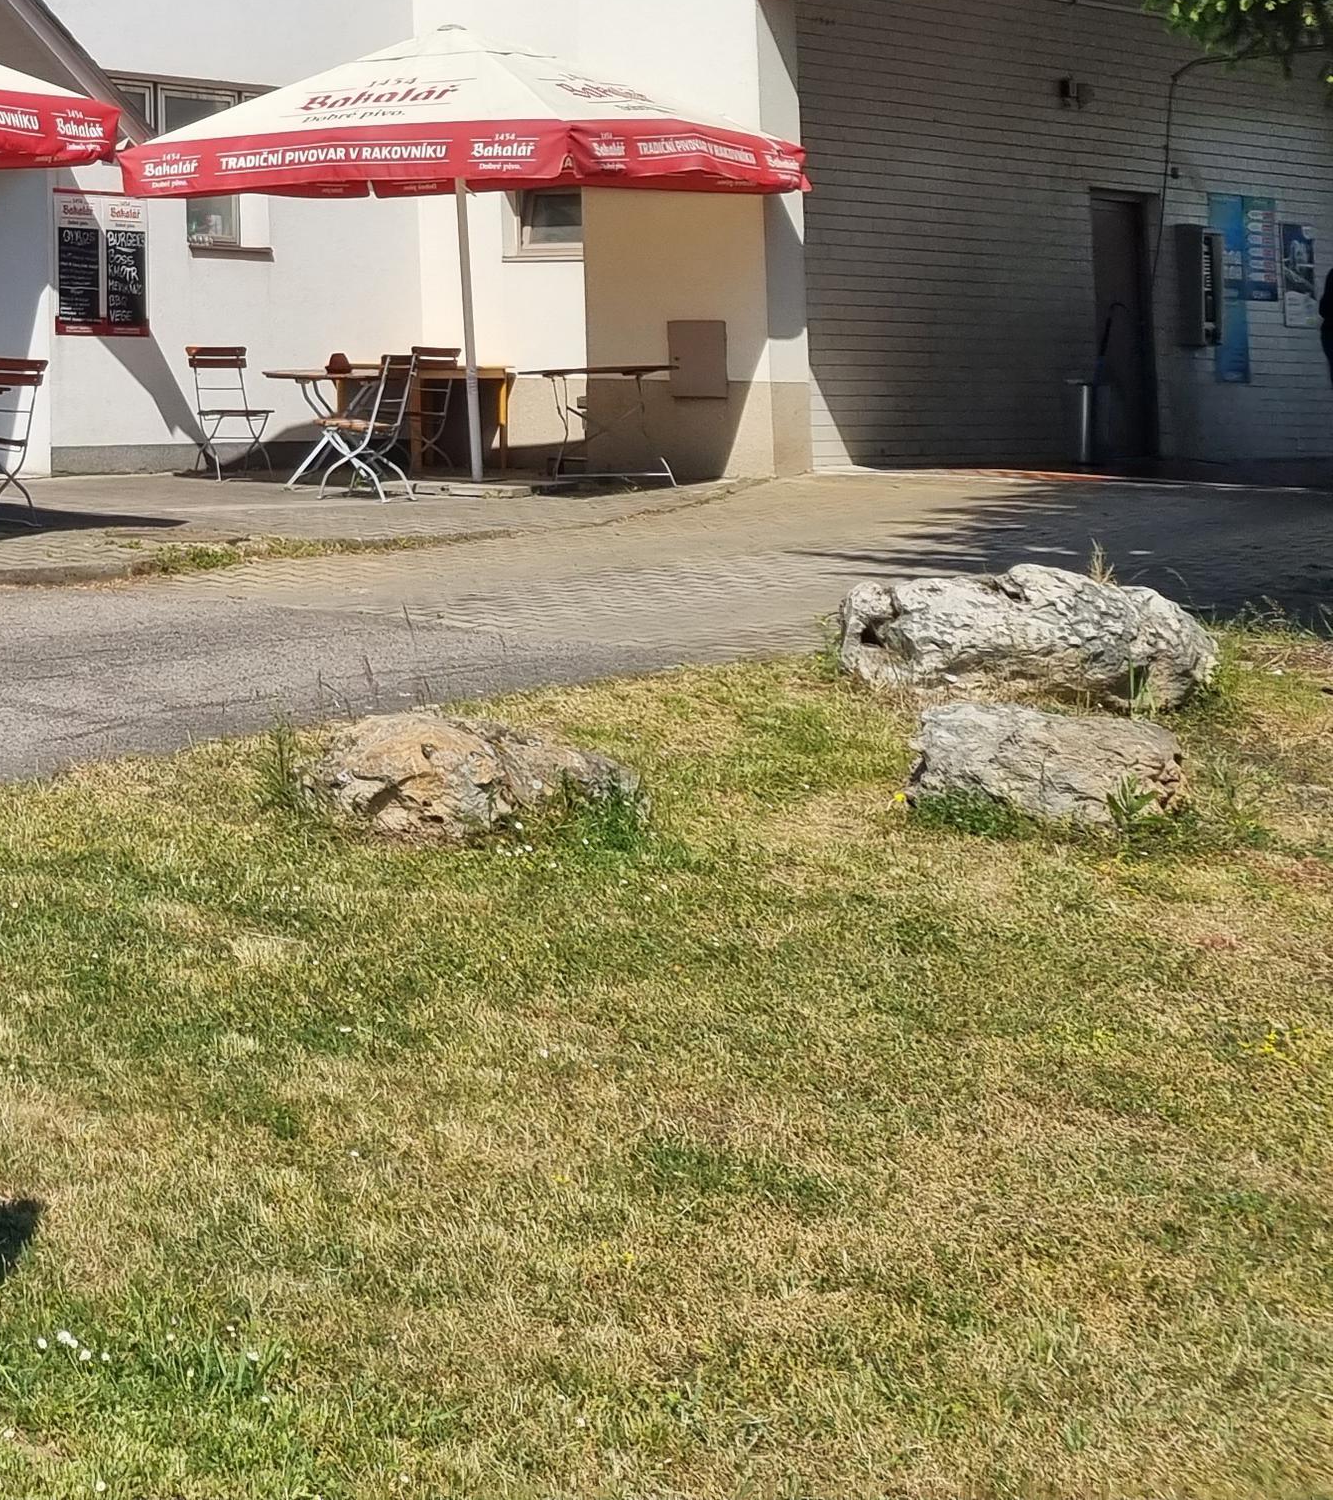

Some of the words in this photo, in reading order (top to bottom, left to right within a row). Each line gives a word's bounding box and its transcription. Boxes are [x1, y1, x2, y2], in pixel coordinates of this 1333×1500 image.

[300, 84, 461, 111] Bakalář
[302, 111, 360, 123] Dobré
[363, 108, 405, 121] pivo.
[55, 117, 104, 138] Bakalář
[494, 132, 516, 141] 1454
[220, 148, 283, 170] TRADIČNÍ
[285, 145, 346, 165] PIVOVAR
[348, 147, 360, 161] V
[362, 142, 447, 160] RAKOVNÍKU
[470, 141, 535, 157] Bakalář
[143, 159, 199, 177] Bakalář
